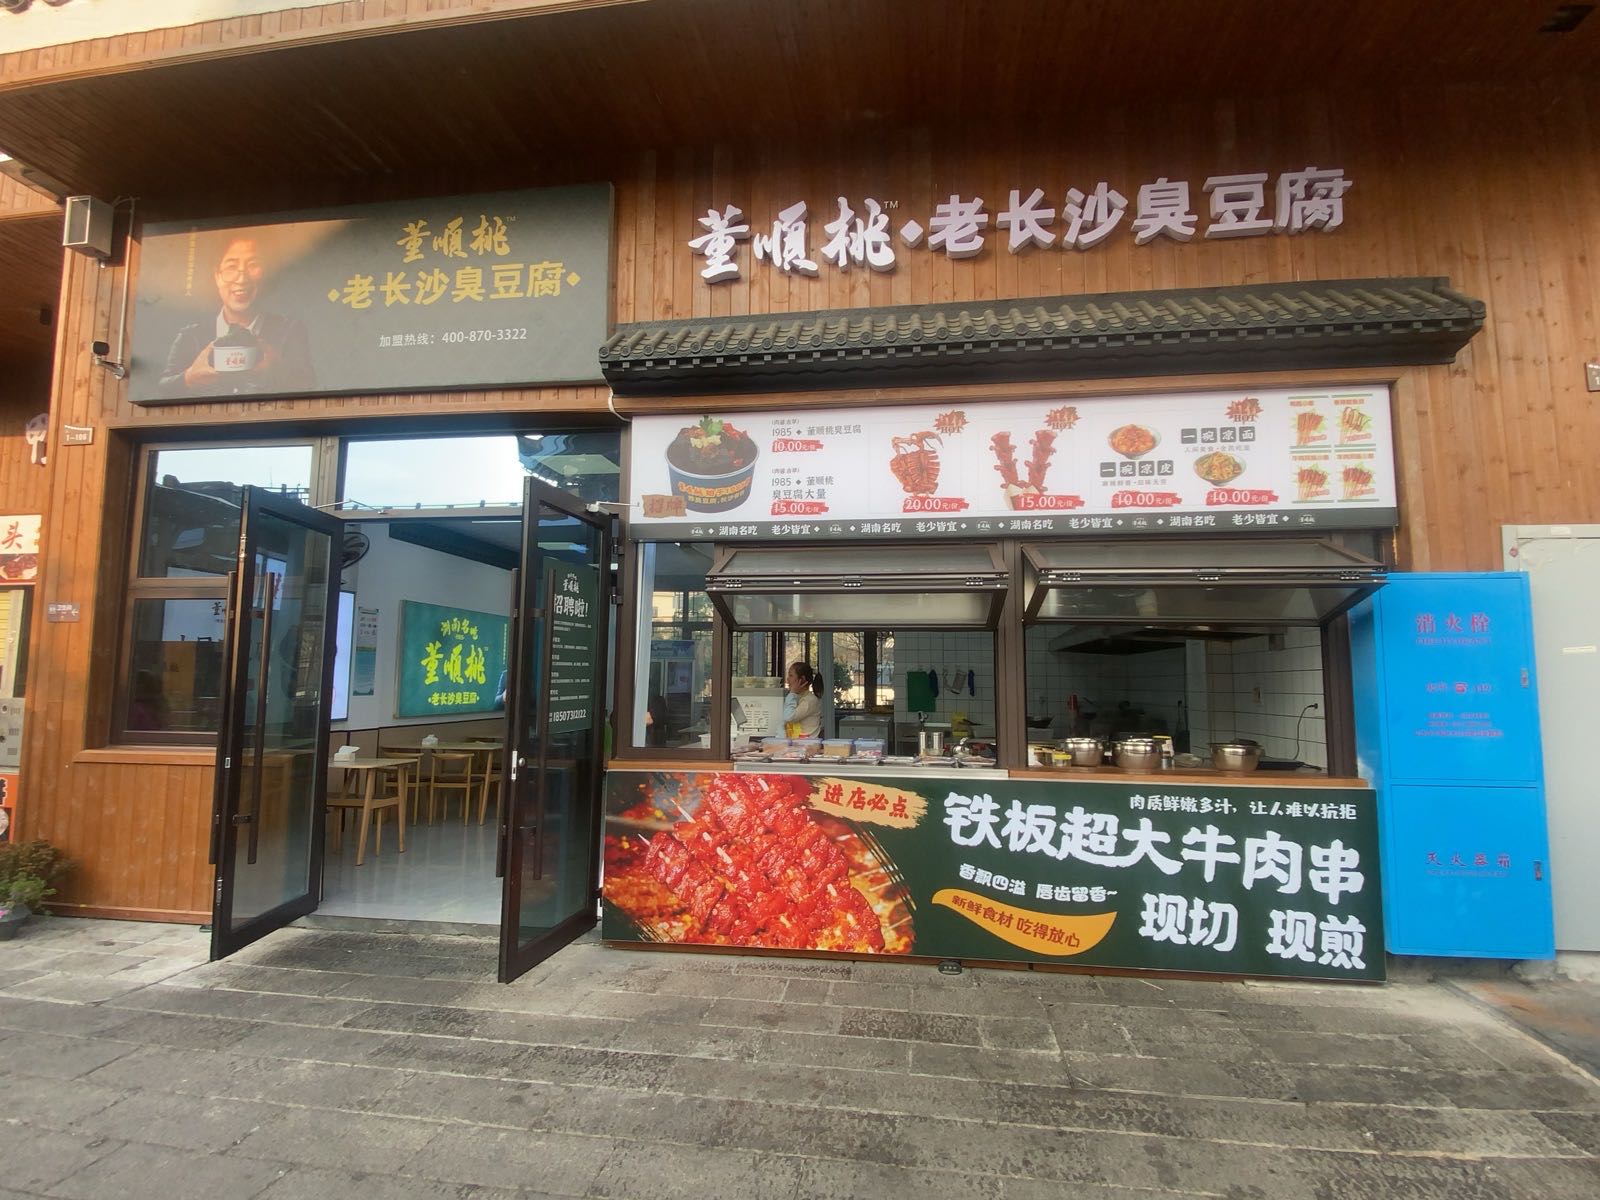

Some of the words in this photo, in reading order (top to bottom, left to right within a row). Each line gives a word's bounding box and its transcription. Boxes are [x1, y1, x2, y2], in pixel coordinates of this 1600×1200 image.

[927, 166, 1352, 258] 老长沙臭豆腐
[342, 261, 566, 308] 老长沙臭豆腐
[772, 428, 792, 436] 1985
[772, 478, 792, 487] 1985
[719, 526, 758, 536] 湖南名吃
[771, 525, 811, 535] 老少皆宜
[861, 523, 901, 533] 湖南名吃
[915, 521, 958, 532] 老少皆宜
[1010, 519, 1053, 530] 湖南名吃
[1069, 517, 1113, 529] 老少皆宜
[1169, 515, 1216, 527] 湖南名吃
[1232, 513, 1278, 525] 老少皆宜
[1, 521, 23, 549] 头
[1416, 612, 1489, 634] 消火栓
[431, 691, 478, 705] 老长沙臭豆腐
[824, 783, 909, 819] 进店必点
[943, 791, 1365, 905] 铁板超大牛肉串
[1426, 851, 1511, 868] 灭火器箱
[959, 863, 1026, 896] 香飘四溢
[952, 894, 1015, 928] 新鲜食材
[1016, 917, 1080, 948] 吃得放心
[1138, 893, 1238, 952] 现切
[1265, 909, 1367, 970] 现煎
